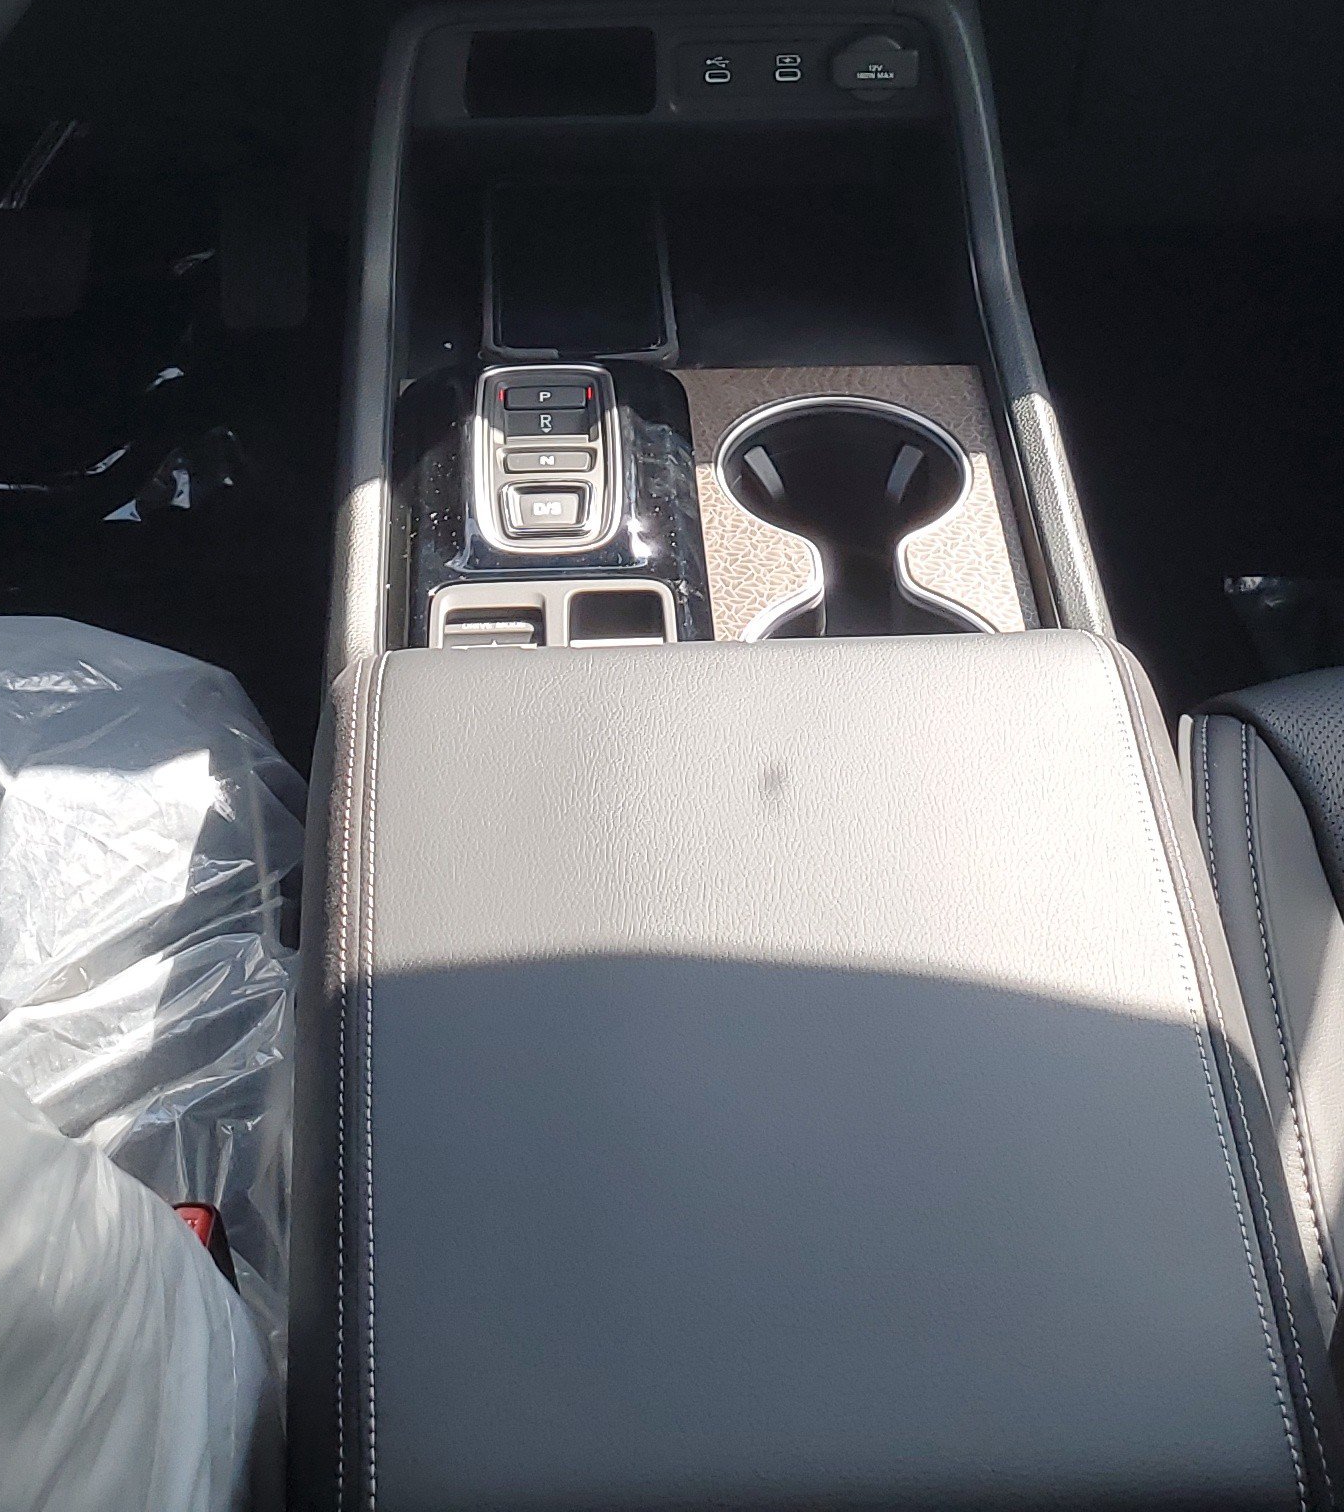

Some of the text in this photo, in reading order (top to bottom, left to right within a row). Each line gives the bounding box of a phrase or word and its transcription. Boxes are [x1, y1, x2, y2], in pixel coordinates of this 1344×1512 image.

[538, 391, 552, 402] P
[539, 414, 552, 428] R
[539, 455, 555, 466] N
